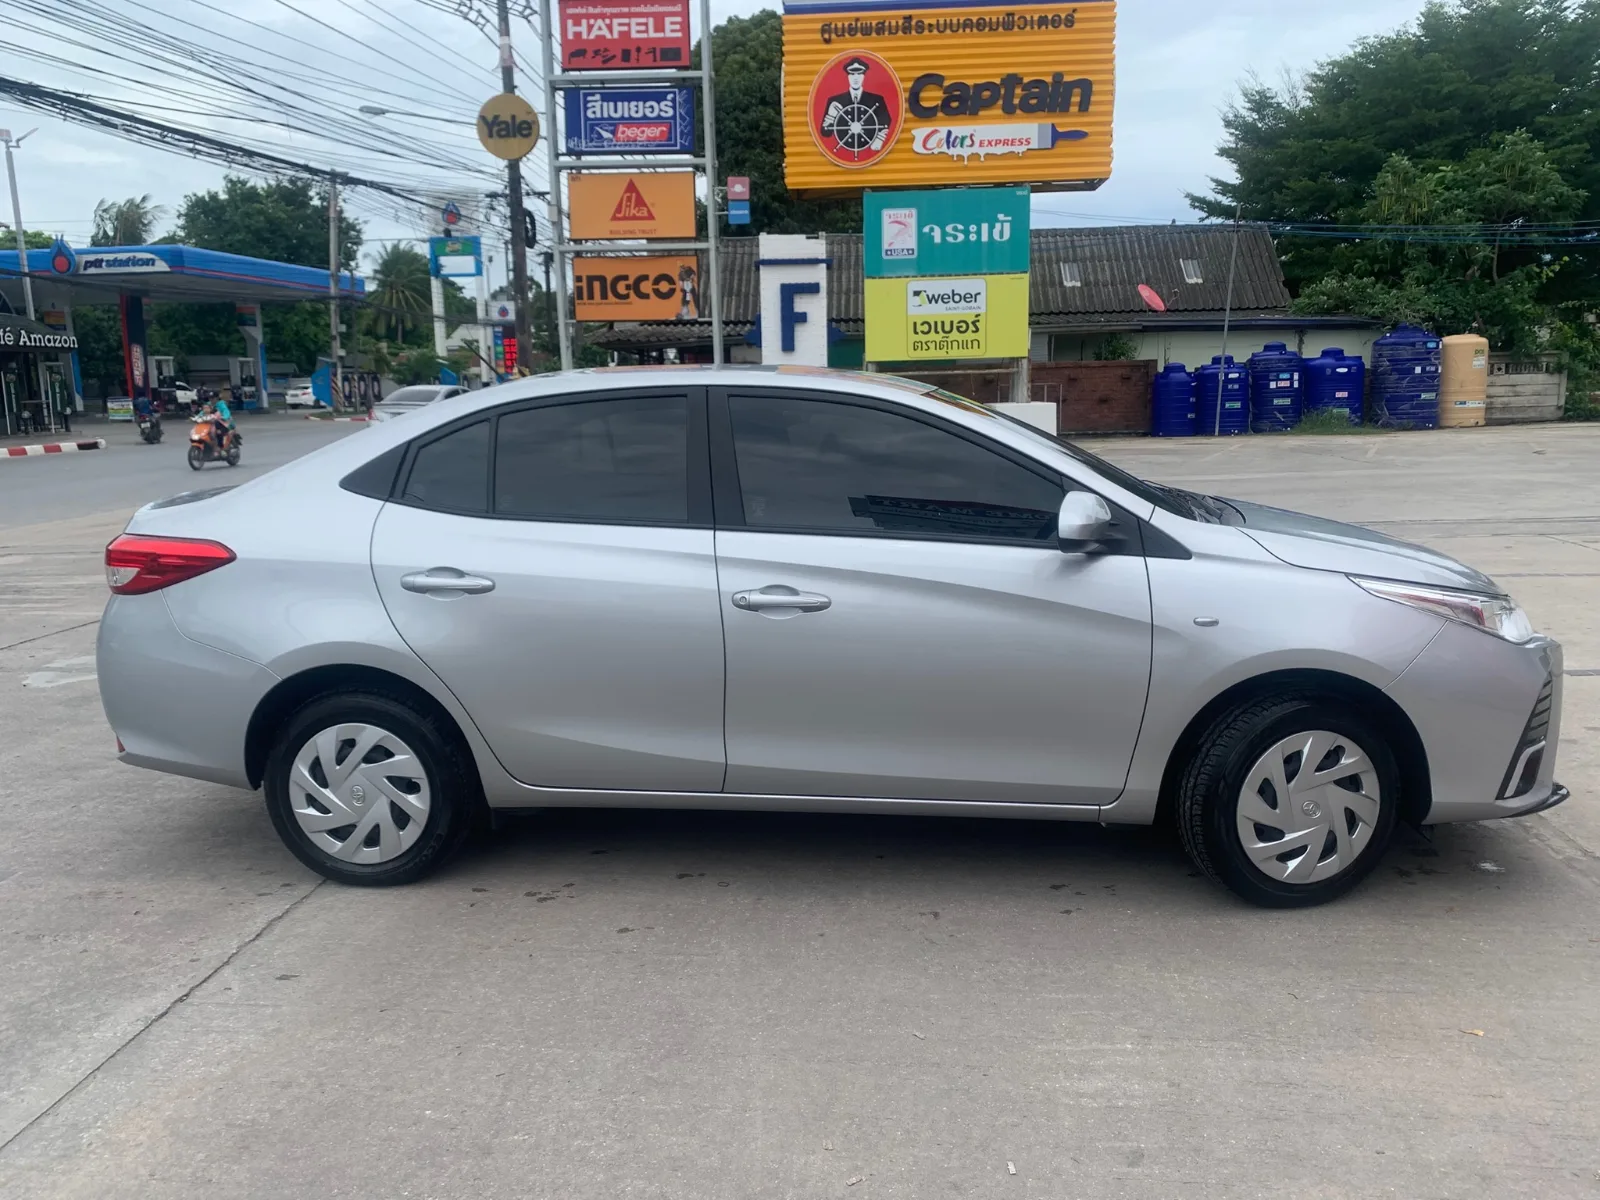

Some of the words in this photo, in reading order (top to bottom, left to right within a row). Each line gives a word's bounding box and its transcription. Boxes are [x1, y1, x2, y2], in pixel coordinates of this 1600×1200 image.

[567, 16, 682, 40] HÄFELE
[586, 94, 674, 118] สีเบเยอร์
[908, 72, 1093, 117] Captain
[479, 114, 533, 138] Yale
[617, 125, 667, 141] beger
[922, 128, 975, 151] Colors
[978, 137, 1031, 148] EXPRESS
[616, 193, 649, 218] Sika
[922, 214, 1012, 244] จระเข้
[104, 255, 156, 268] station
[891, 248, 908, 256] USA
[926, 289, 981, 305] weber
[780, 282, 820, 352] F
[913, 314, 981, 335] เวเบอร์
[19, 329, 78, 348] Amazon
[913, 336, 980, 354] ตราตุ๊กแก
